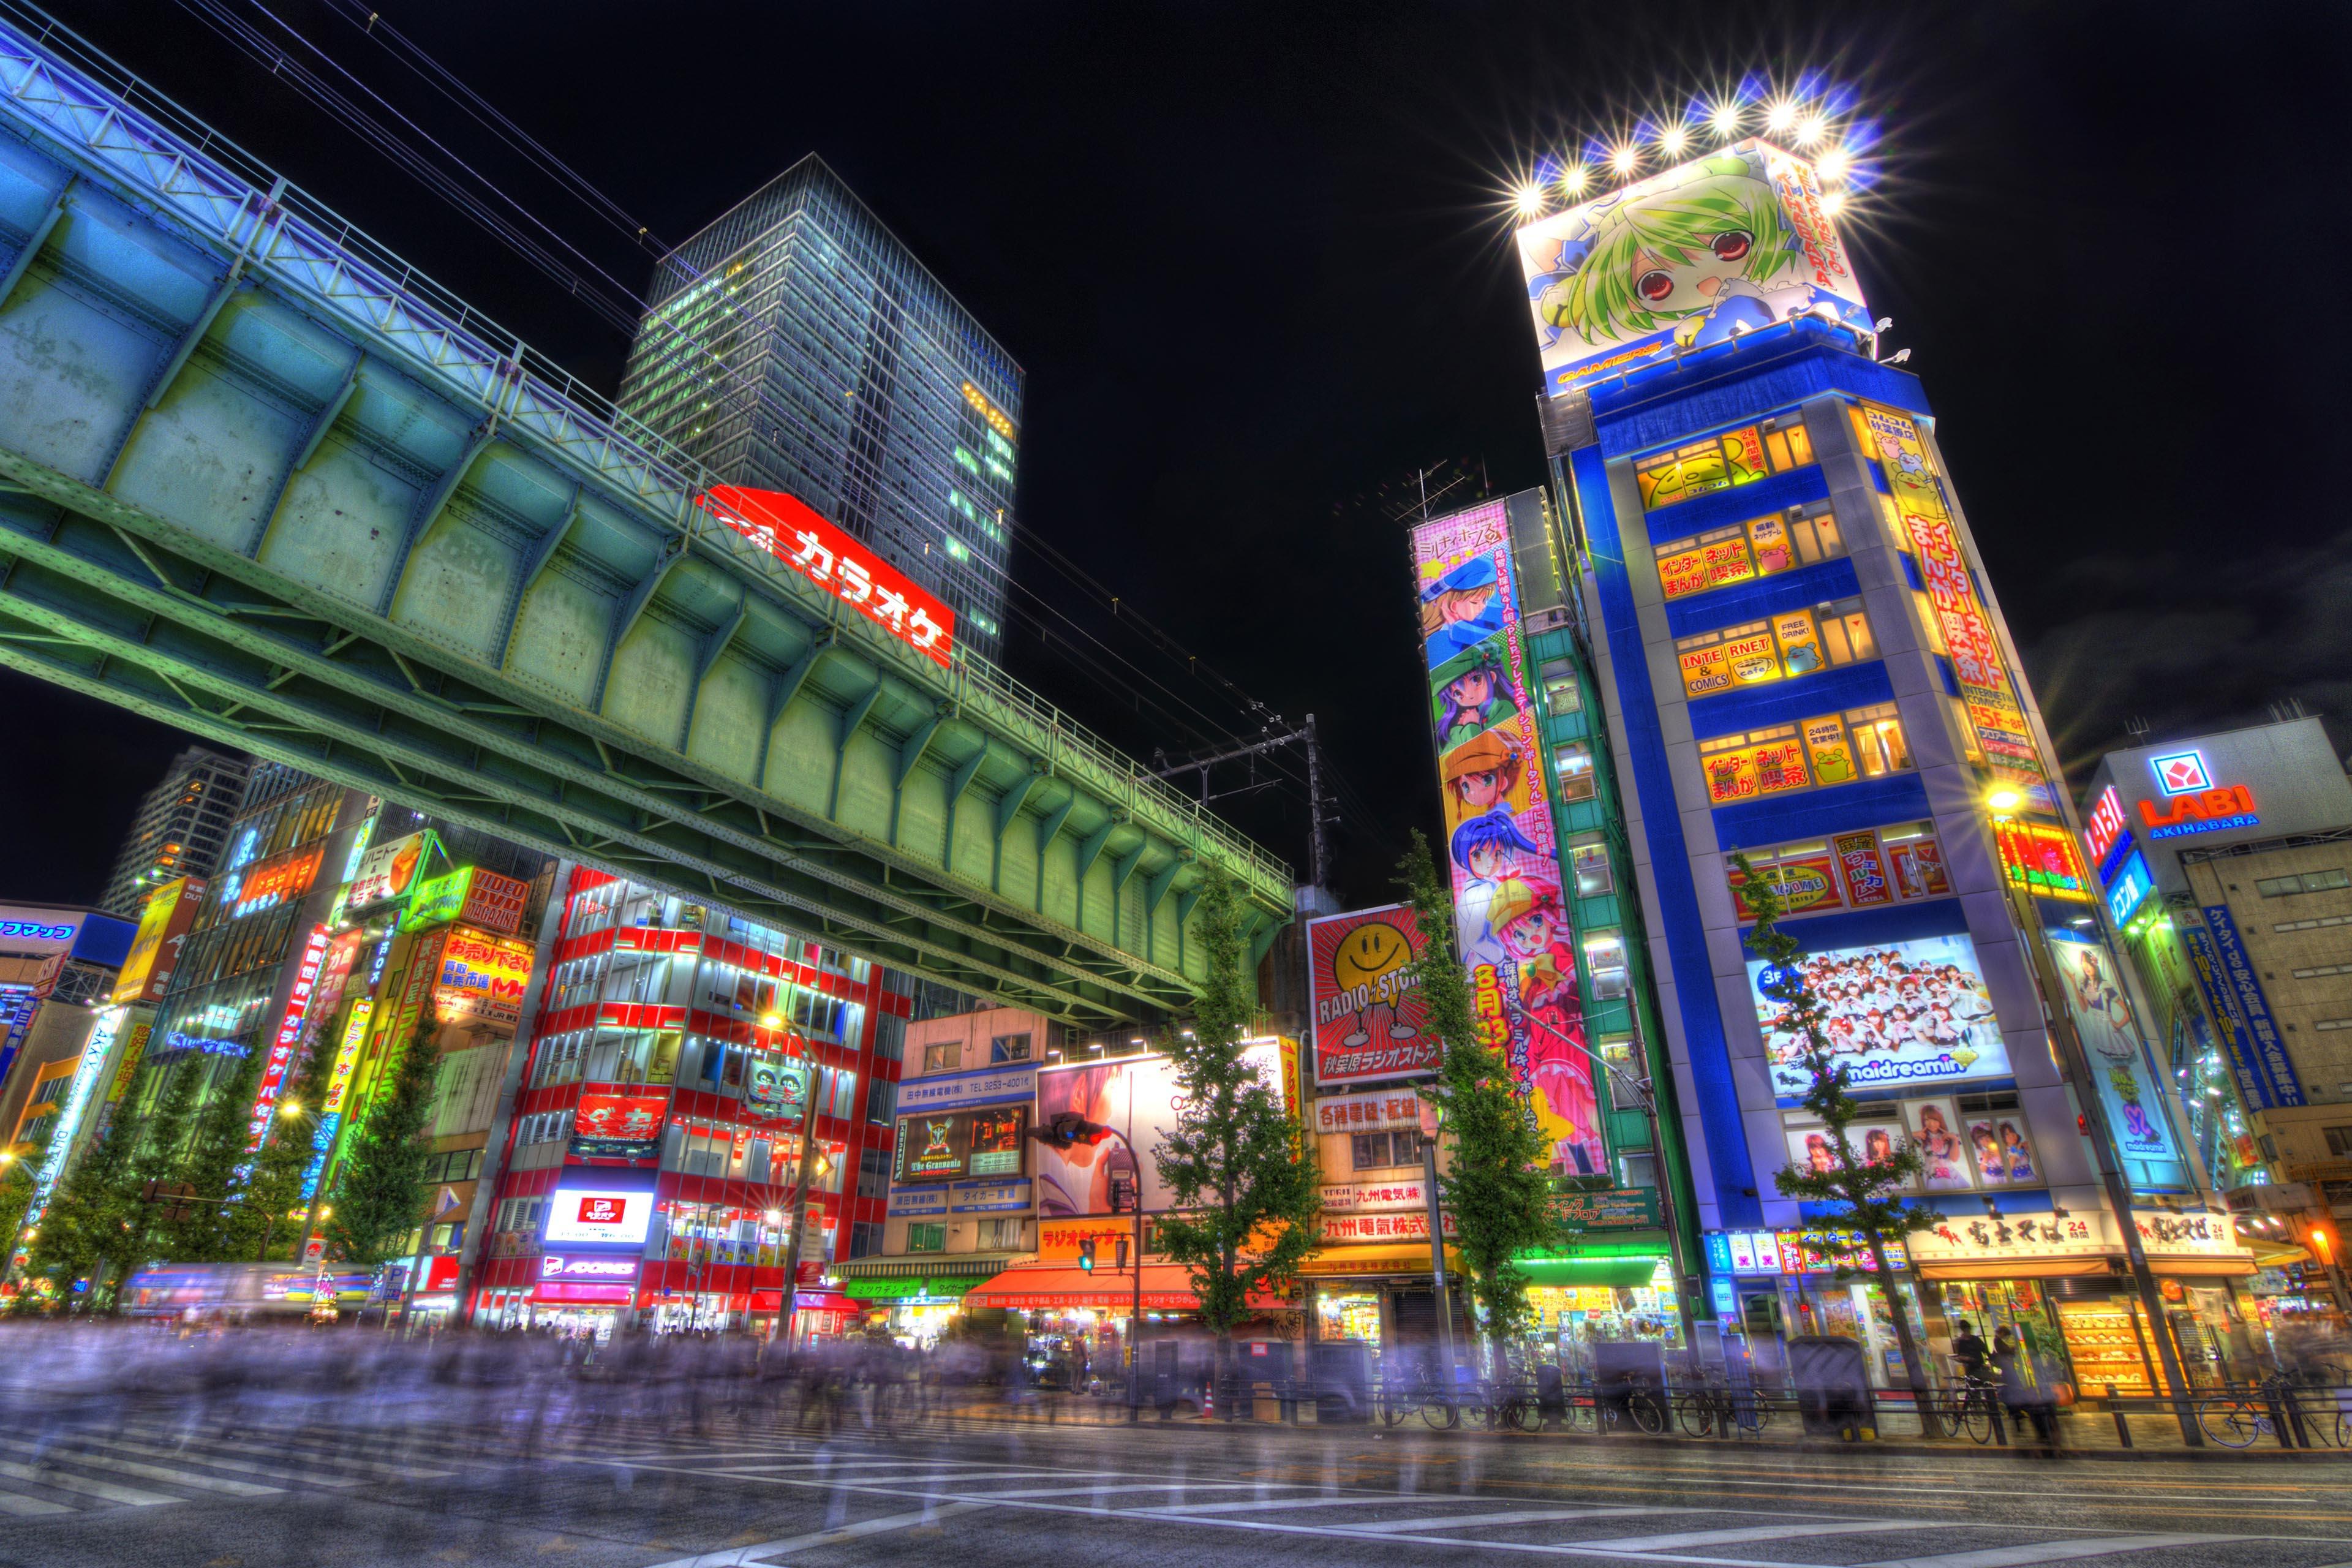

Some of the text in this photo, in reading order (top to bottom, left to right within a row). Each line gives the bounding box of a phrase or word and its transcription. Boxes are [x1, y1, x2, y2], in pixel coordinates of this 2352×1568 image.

[1771, 156, 1838, 292] KIHABARA
[1791, 162, 1848, 277] WELCOME TO
[1558, 340, 1664, 385] GAMERS
[1868, 410, 1912, 429] コムコム
[1871, 420, 1917, 442] 秋葉原店
[1740, 428, 1764, 471] 24時間営業
[1754, 529, 1782, 540] ネットゲーム
[1755, 519, 1776, 533] 最新
[793, 530, 943, 649] カラオケ
[1908, 516, 1983, 686] まんが喫茶
[1932, 522, 2003, 688] インターネット
[1781, 619, 1806, 631] FREE
[1782, 627, 1810, 640] DRINK!
[1700, 666, 1713, 676] &
[1740, 666, 1765, 677] cafe
[1689, 674, 1729, 693] COMICS
[1963, 684, 2007, 702] INTERNET
[1809, 724, 1839, 736] 24時間
[1810, 733, 1841, 746] 営業中!
[2139, 785, 2256, 827] LABI
[2150, 813, 2260, 840] AKIHABARA
[1839, 837, 1875, 855] 麻雀
[473, 870, 526, 899] VIDEO
[468, 889, 522, 913] DVD
[1858, 895, 1885, 904] AKIBA
[464, 903, 519, 932] MAGAZINE
[448, 939, 532, 974] お売り下さい
[444, 960, 467, 974] 買取
[440, 971, 490, 990] 販売 市場
[1763, 970, 1782, 984] 3F
[1319, 982, 1370, 1025] RADIO
[1324, 1043, 1437, 1076] 秋葉原ラジオストア
[970, 1082, 981, 1093] TEL
[911, 1162, 924, 1172] The
[1325, 1215, 1458, 1237] 九州電氣株式社
[2067, 1221, 2088, 1232] 24
[2069, 1231, 2090, 1240] 時間
[2212, 1224, 2223, 1233] 24
[391, 1268, 402, 1281] P
